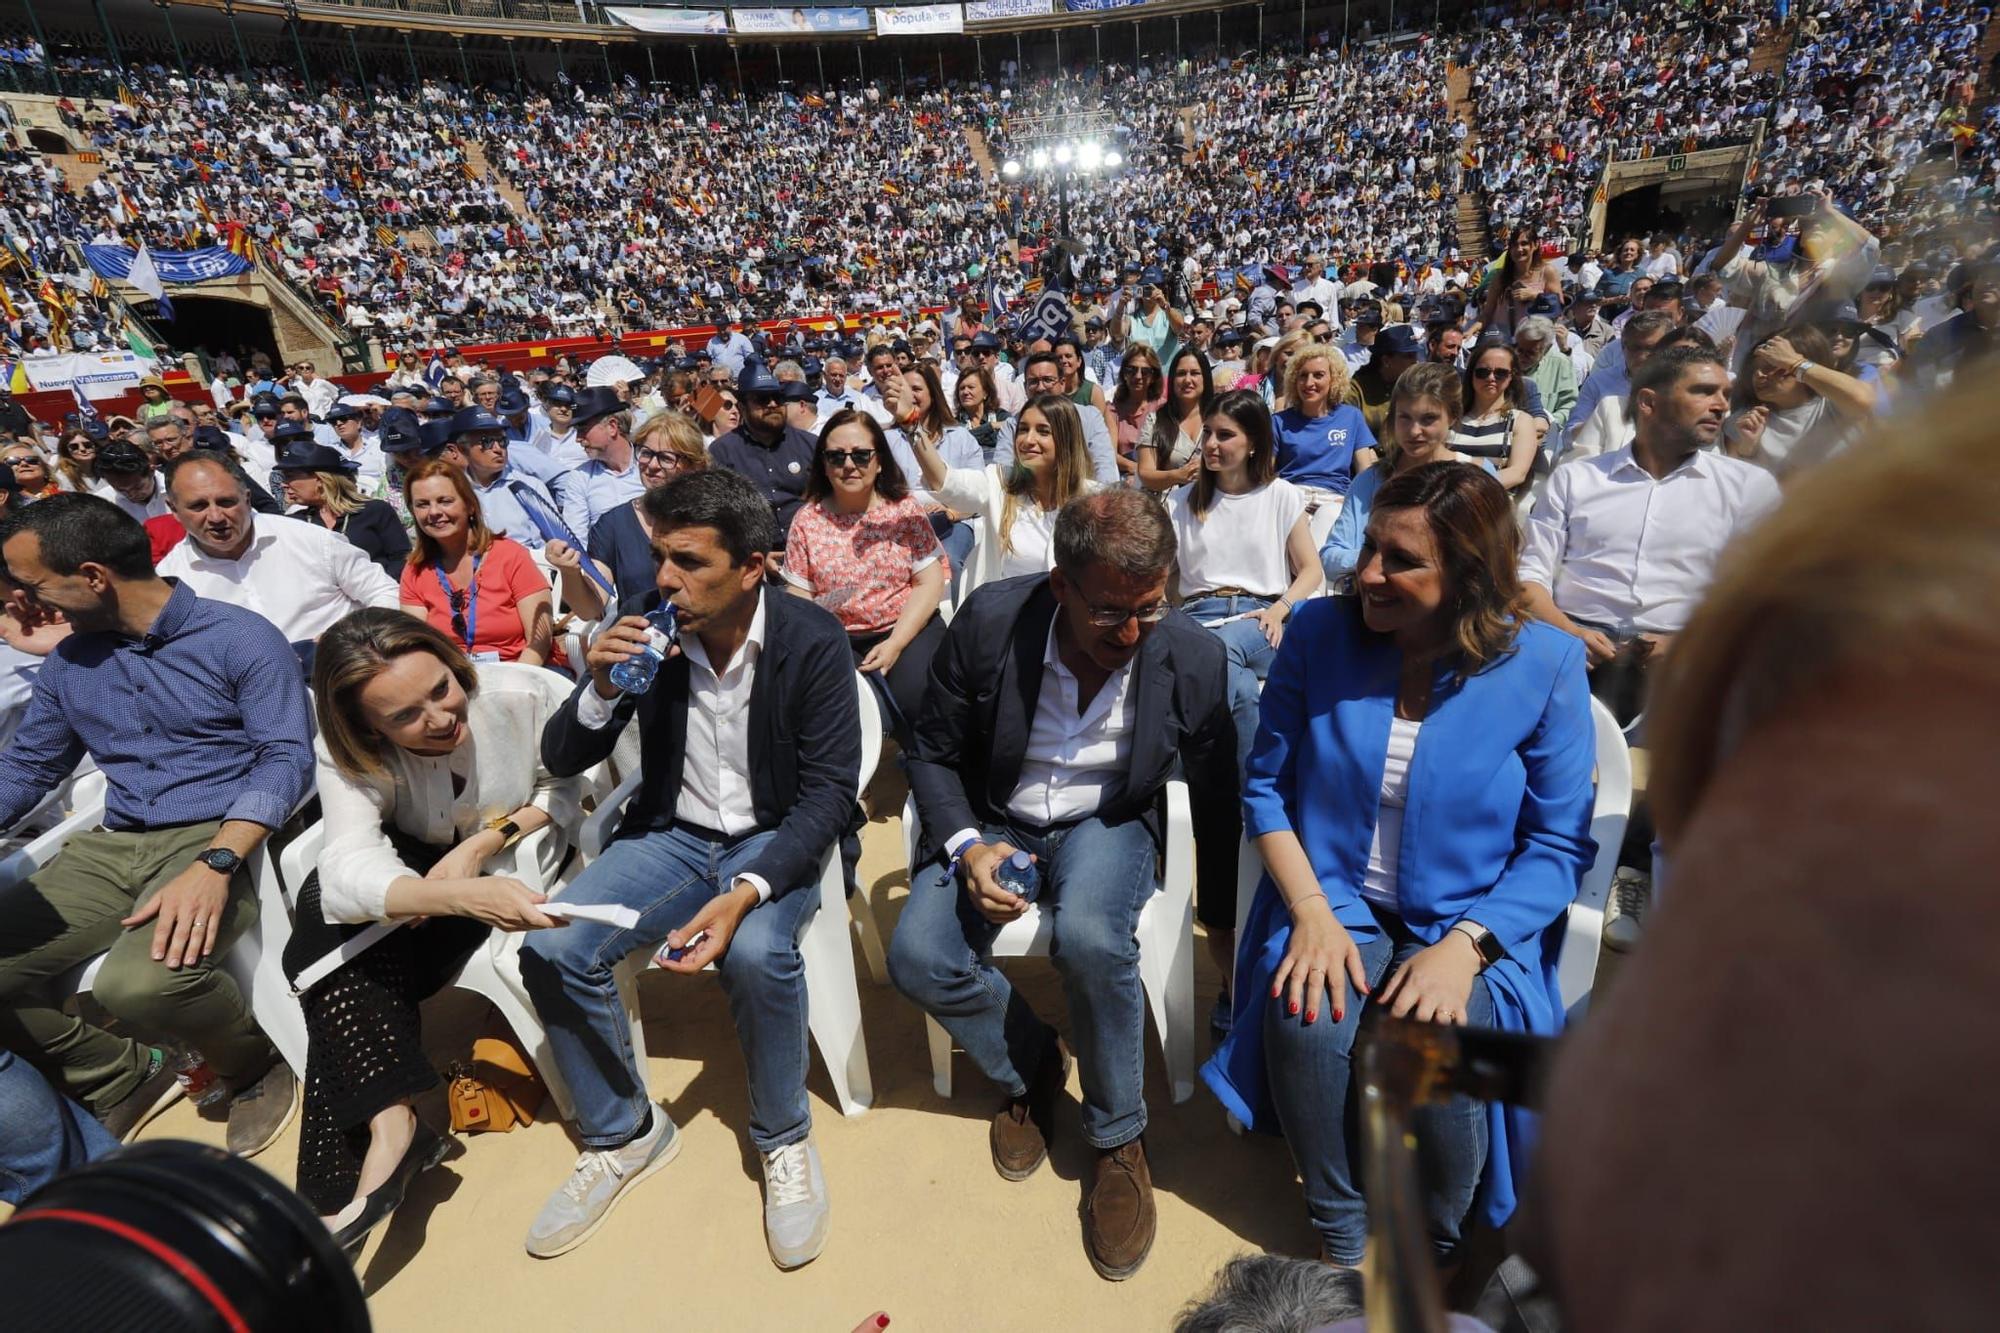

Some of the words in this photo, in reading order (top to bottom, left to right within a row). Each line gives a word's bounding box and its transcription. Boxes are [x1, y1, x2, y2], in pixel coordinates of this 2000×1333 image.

[986, 0, 1032, 10] ORIHUELA
[969, 11, 987, 19] CON
[988, 9, 1019, 18] CARLOS
[116, 256, 179, 273] VTA
[39, 379, 74, 389] Nuevo
[76, 373, 136, 384] Valencianos
